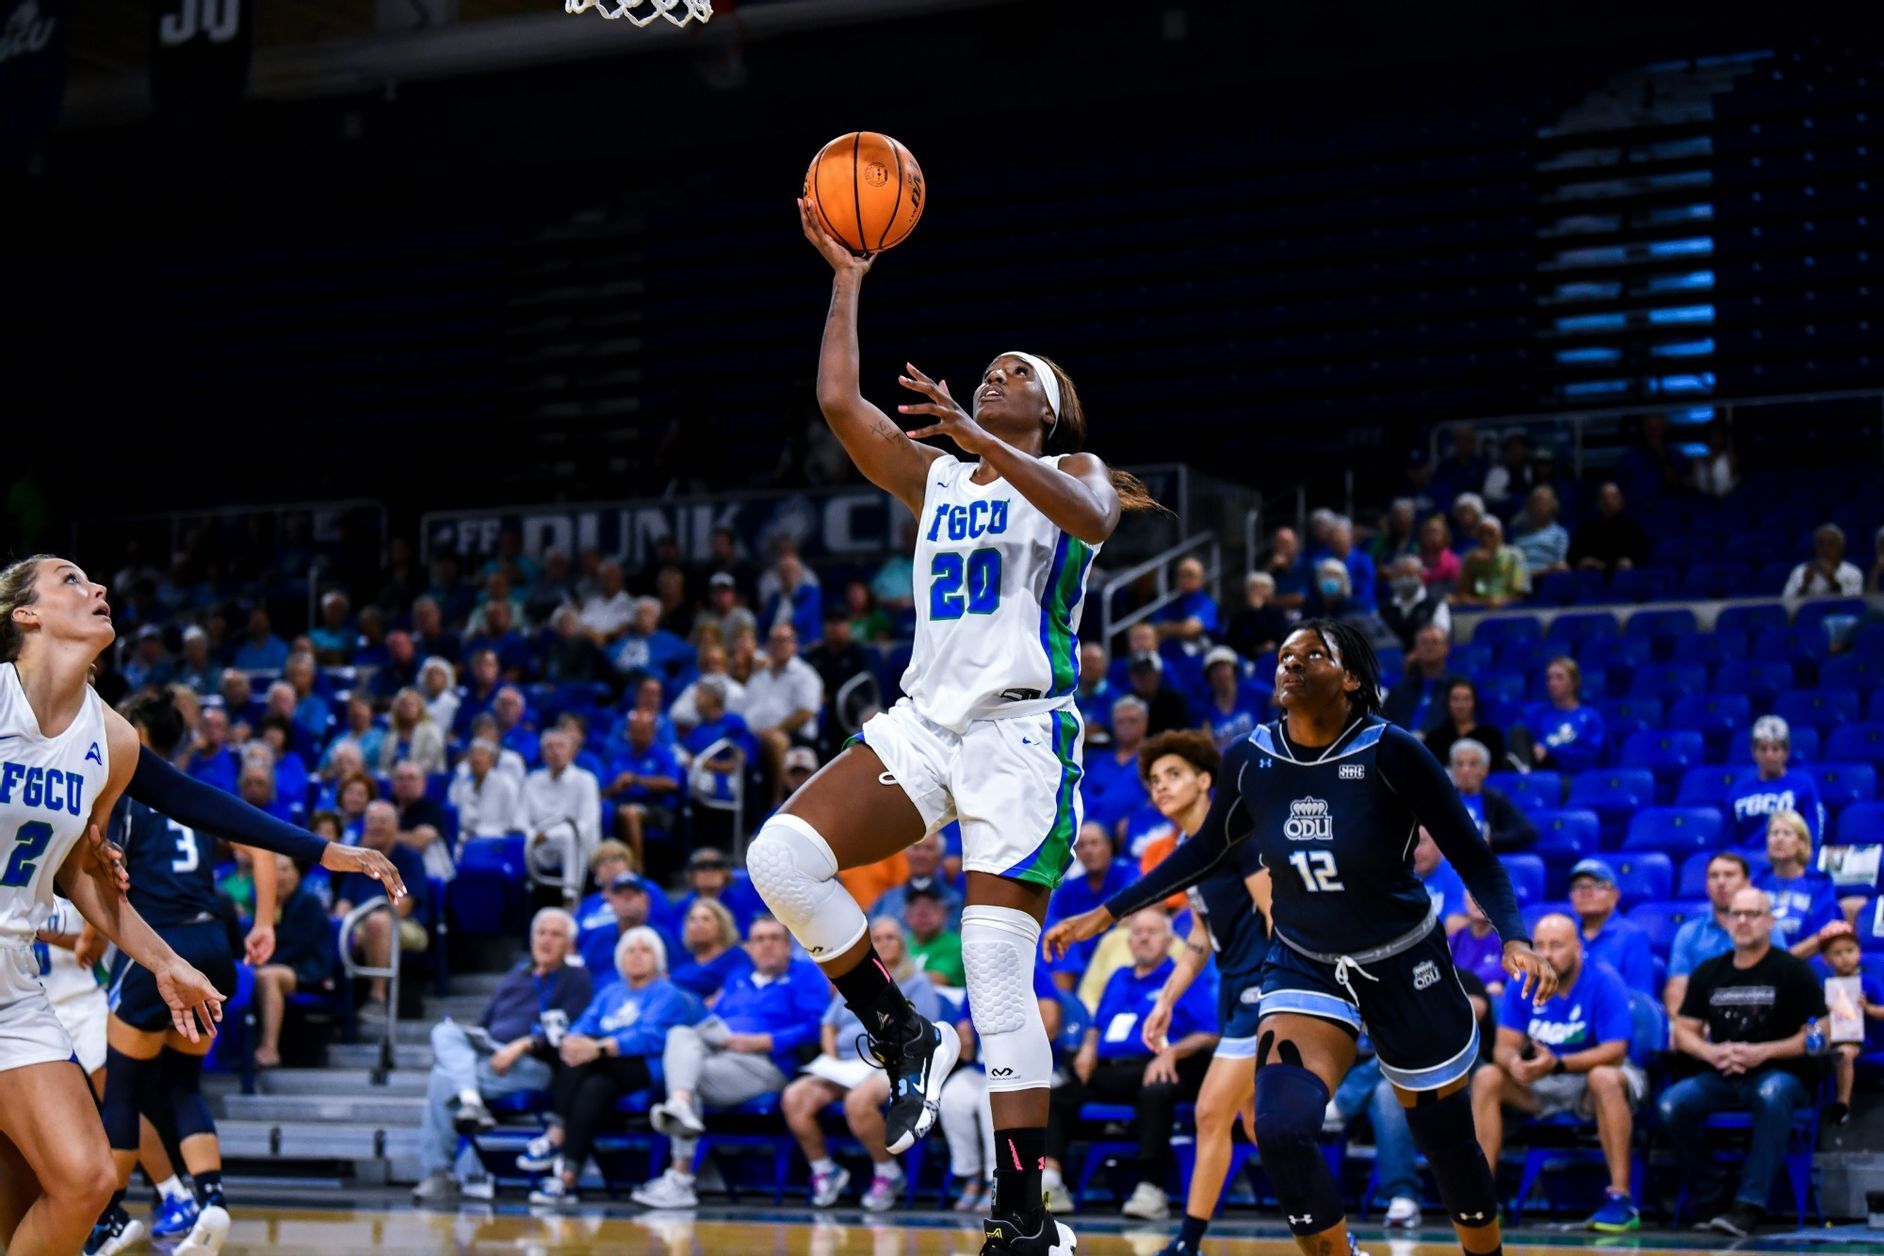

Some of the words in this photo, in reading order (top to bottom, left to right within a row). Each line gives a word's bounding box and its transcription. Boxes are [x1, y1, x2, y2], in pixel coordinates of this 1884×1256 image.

[929, 547, 1003, 622] 20
[0, 761, 84, 816] FGCU
[0, 820, 54, 888] 2
[166, 817, 200, 873] 3
[1284, 815, 1334, 842] ODU
[1289, 850, 1345, 893] 12
